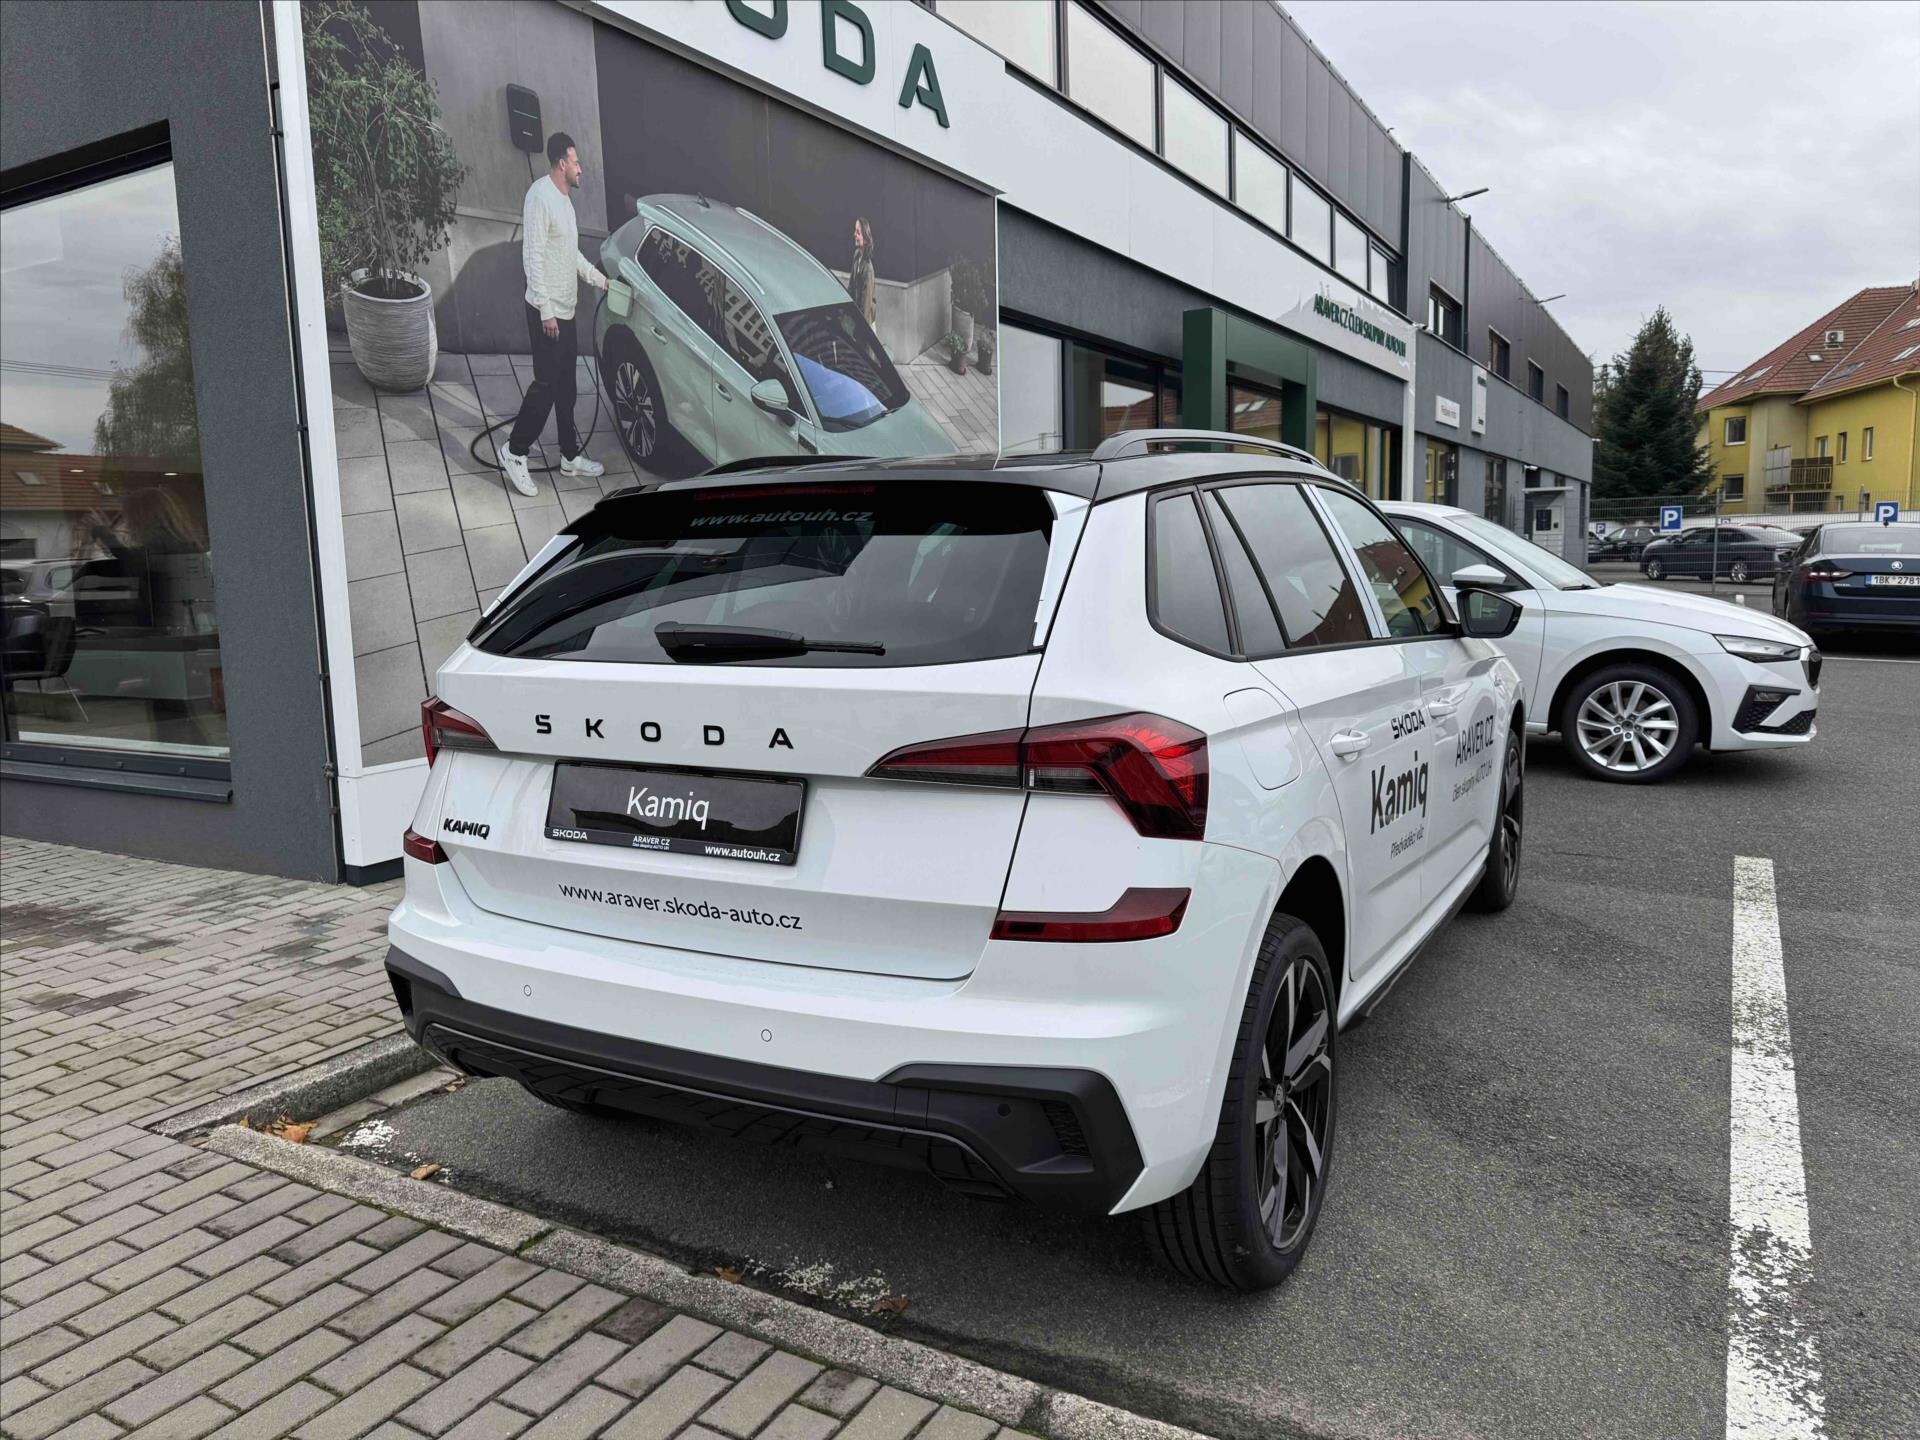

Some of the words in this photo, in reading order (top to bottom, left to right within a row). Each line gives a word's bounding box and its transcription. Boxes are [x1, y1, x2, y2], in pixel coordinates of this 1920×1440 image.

[690, 509, 873, 527] www.autouh.cz
[1663, 509, 1678, 527] P
[1879, 505, 1895, 521] P
[1874, 576, 1890, 584] 1BK
[1455, 720, 1484, 768] ARAVER
[1485, 714, 1493, 747] CZ
[1370, 750, 1428, 835] Kamiq
[626, 786, 709, 830] Kamiq
[443, 817, 490, 840] KAMIQ
[632, 835, 660, 845] ARAVER
[660, 838, 671, 846] CZ
[705, 845, 781, 862] www.autouh.cz
[558, 883, 802, 930] www.araver.skoda-auto.cz
